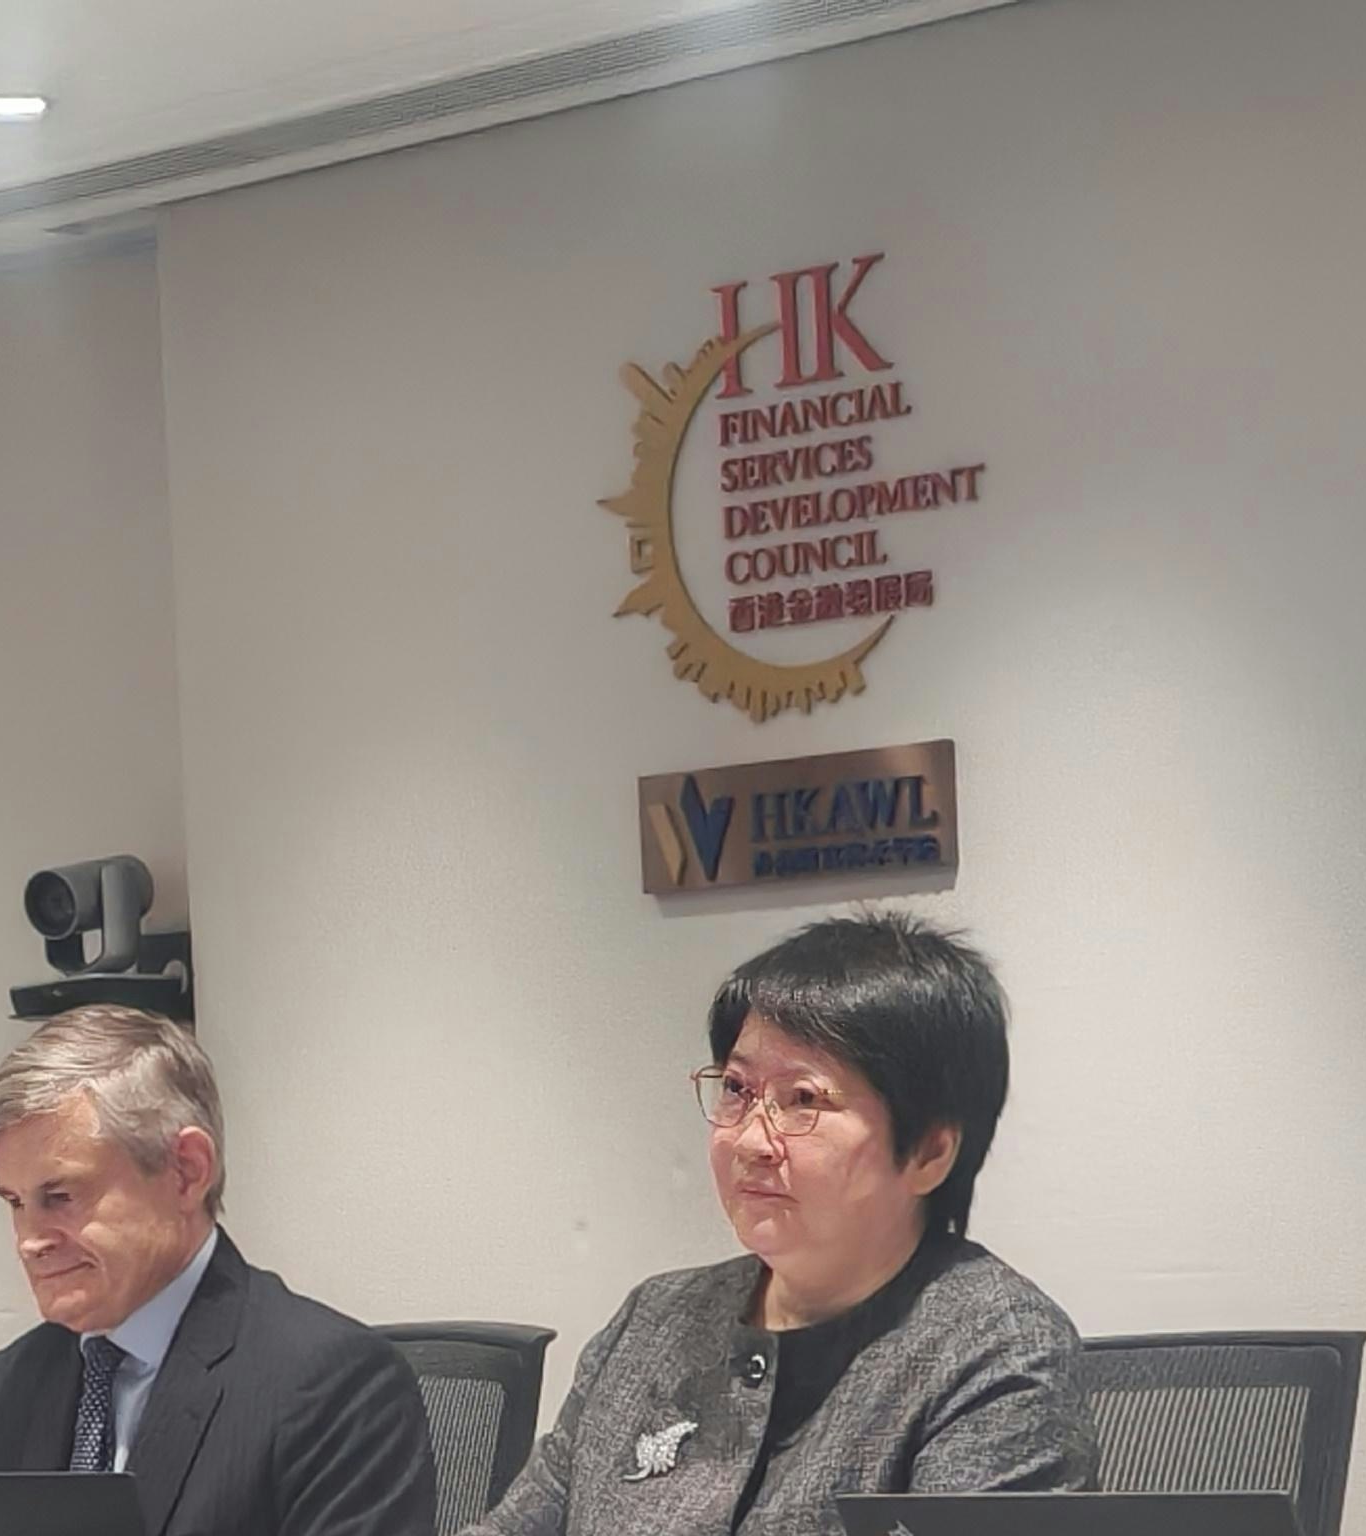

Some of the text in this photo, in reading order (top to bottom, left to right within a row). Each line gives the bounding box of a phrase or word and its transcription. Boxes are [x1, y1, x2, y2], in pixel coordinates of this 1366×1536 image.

[711, 252, 894, 400] HK
[718, 381, 912, 447] FINANCIAL
[720, 435, 873, 492] SERVICES
[723, 463, 985, 540] DEVELOPMENT
[725, 530, 887, 584] COUNCIL
[750, 775, 940, 844] HKAWL
